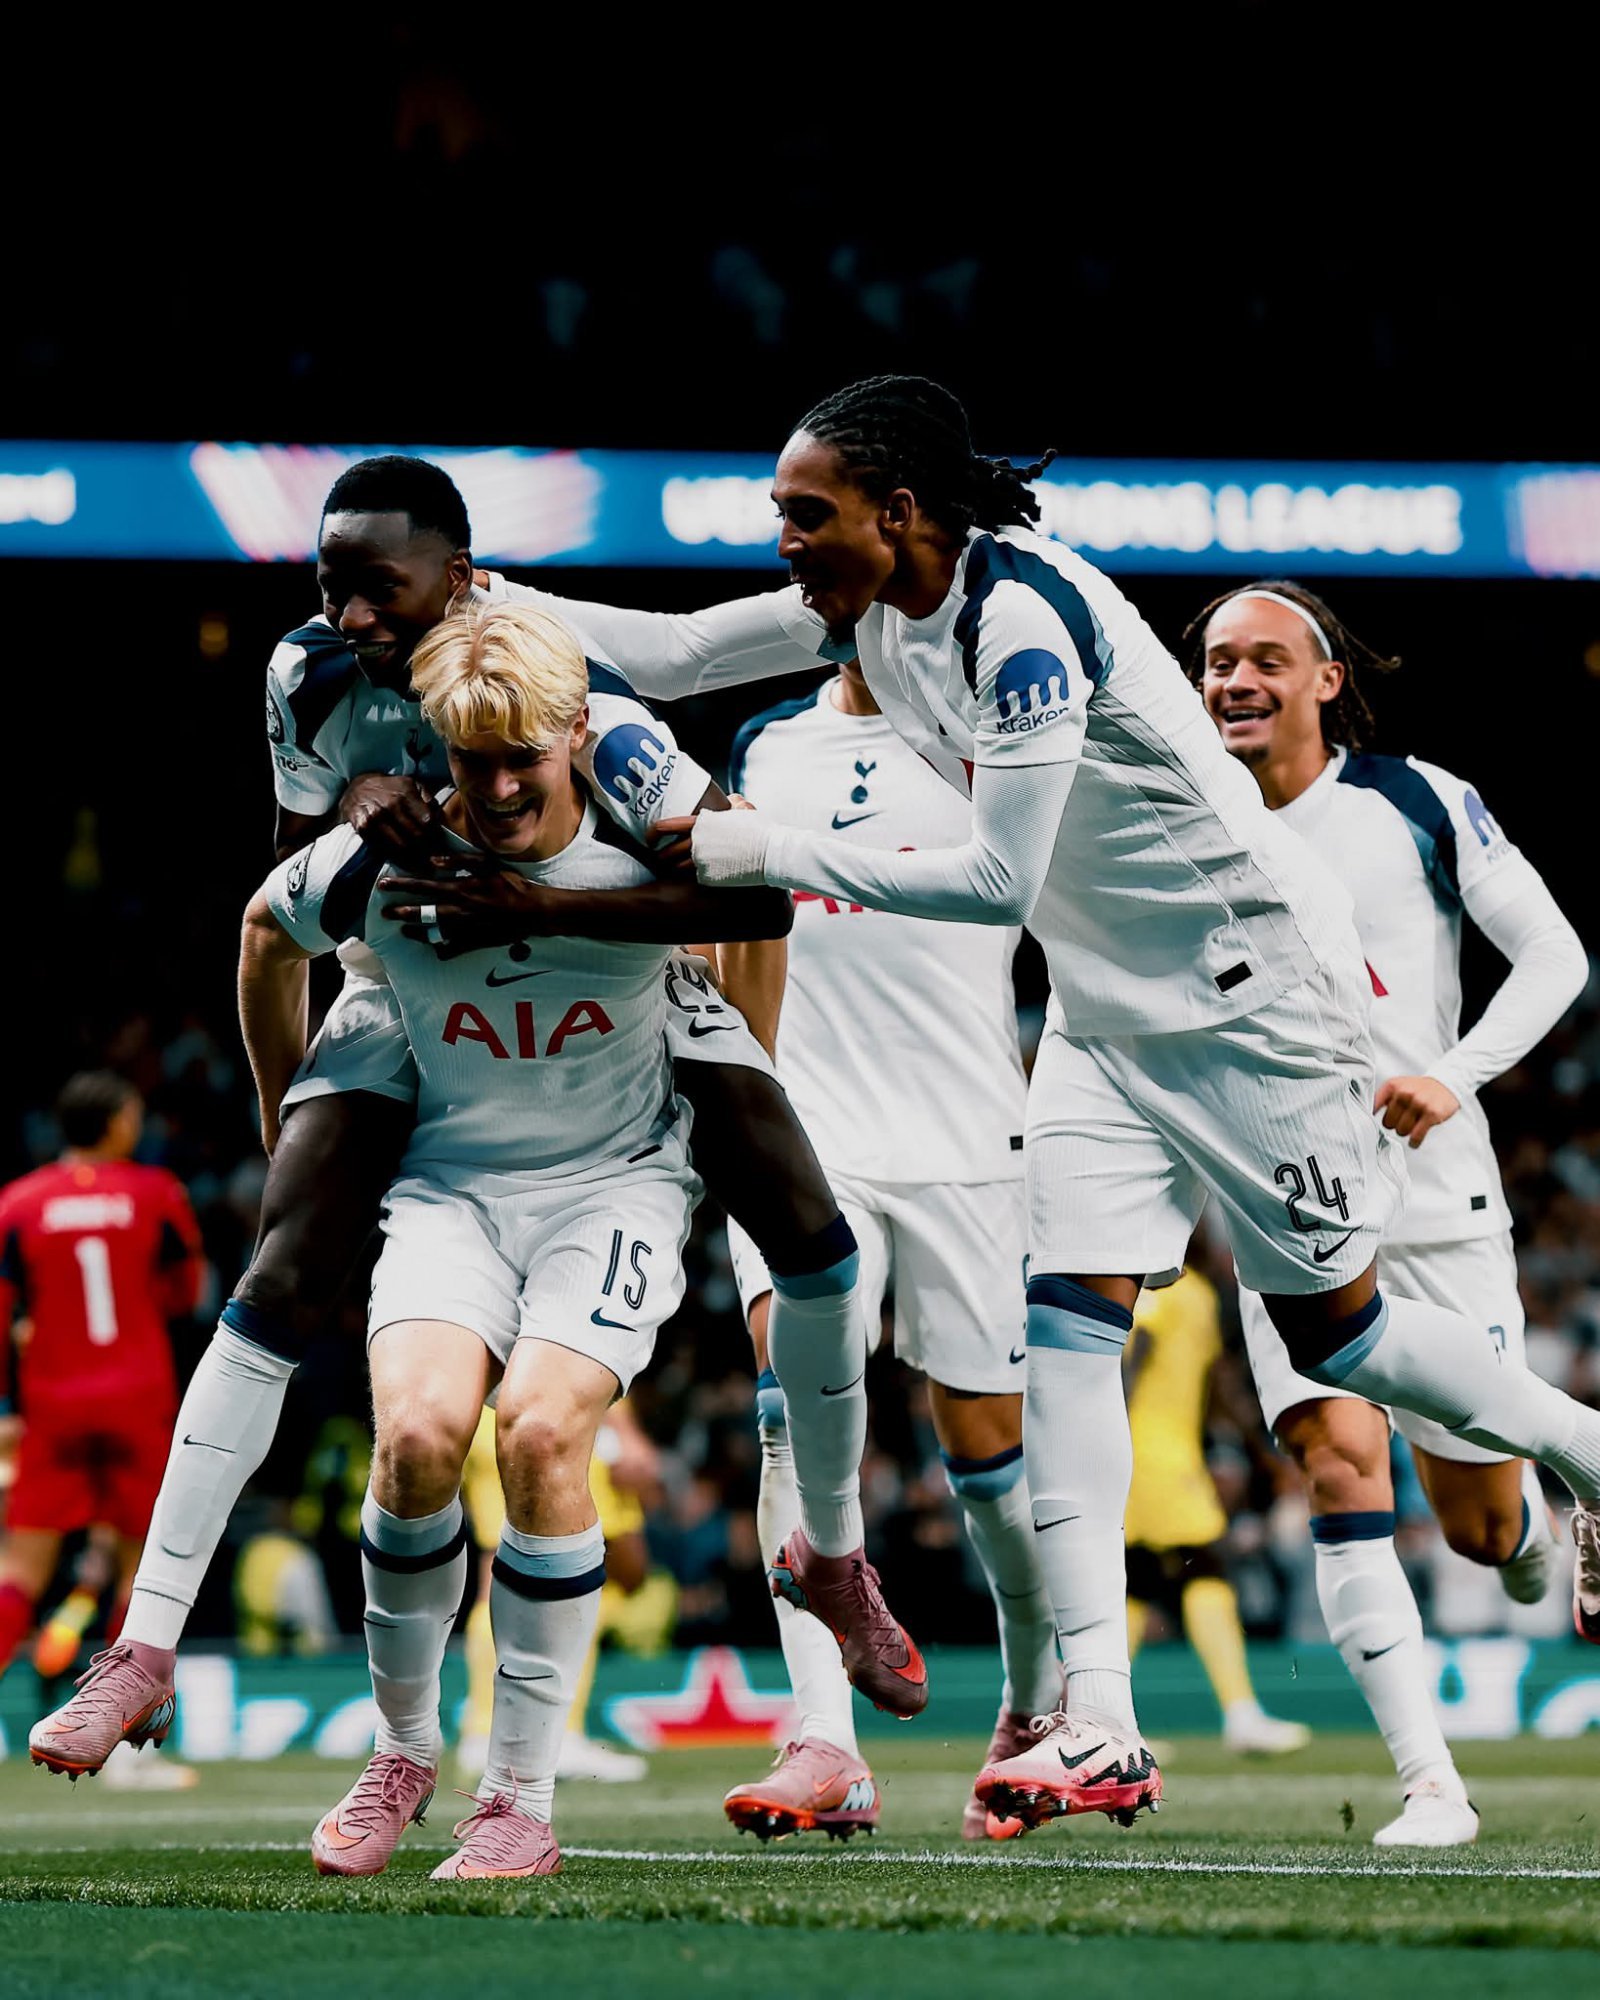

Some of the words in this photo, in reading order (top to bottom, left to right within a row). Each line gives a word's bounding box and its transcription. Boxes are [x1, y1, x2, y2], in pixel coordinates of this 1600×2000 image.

[629, 754, 677, 818] kraken
[442, 1001, 615, 1060] AIA
[1274, 1155, 1350, 1232] 24
[75, 1236, 118, 1346] 1
[602, 1229, 652, 1310] 15
